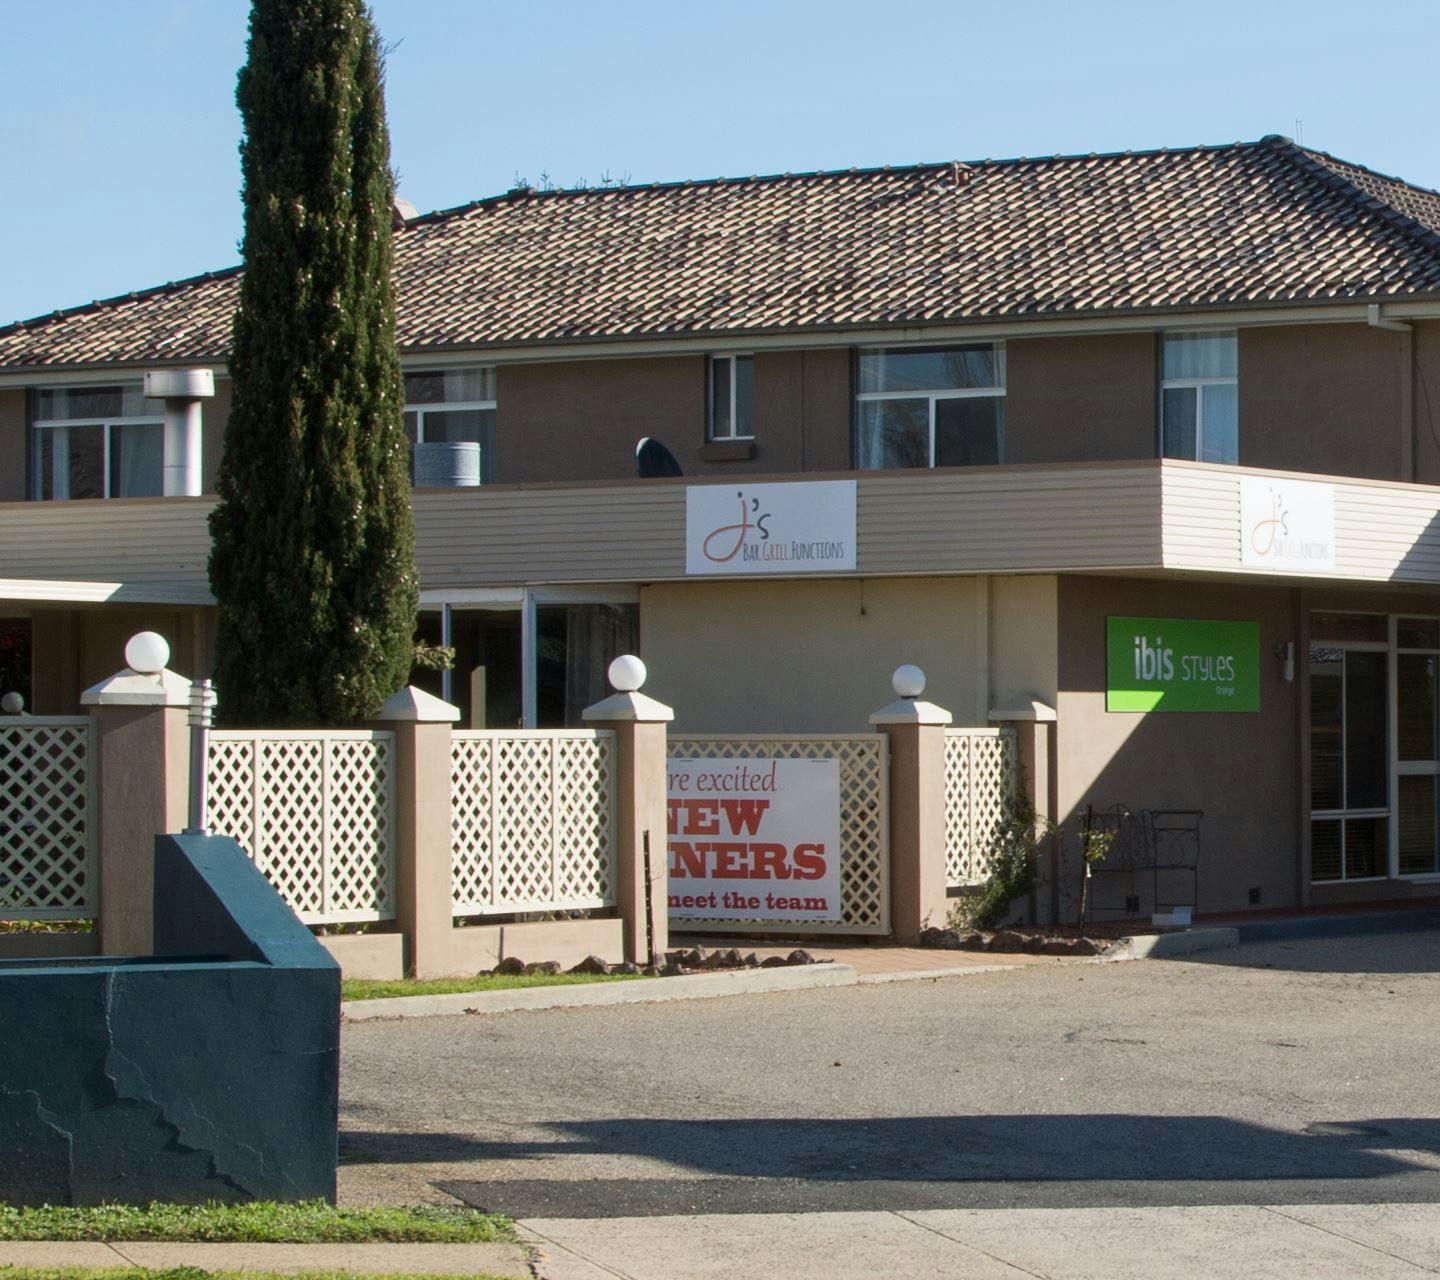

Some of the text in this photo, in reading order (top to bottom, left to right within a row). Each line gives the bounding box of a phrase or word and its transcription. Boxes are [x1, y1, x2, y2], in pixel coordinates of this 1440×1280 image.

[1134, 635, 1175, 681] ibis
[696, 760, 778, 792] excited
[667, 841, 827, 880] NERS
[722, 891, 760, 910] the
[765, 892, 829, 911] team
